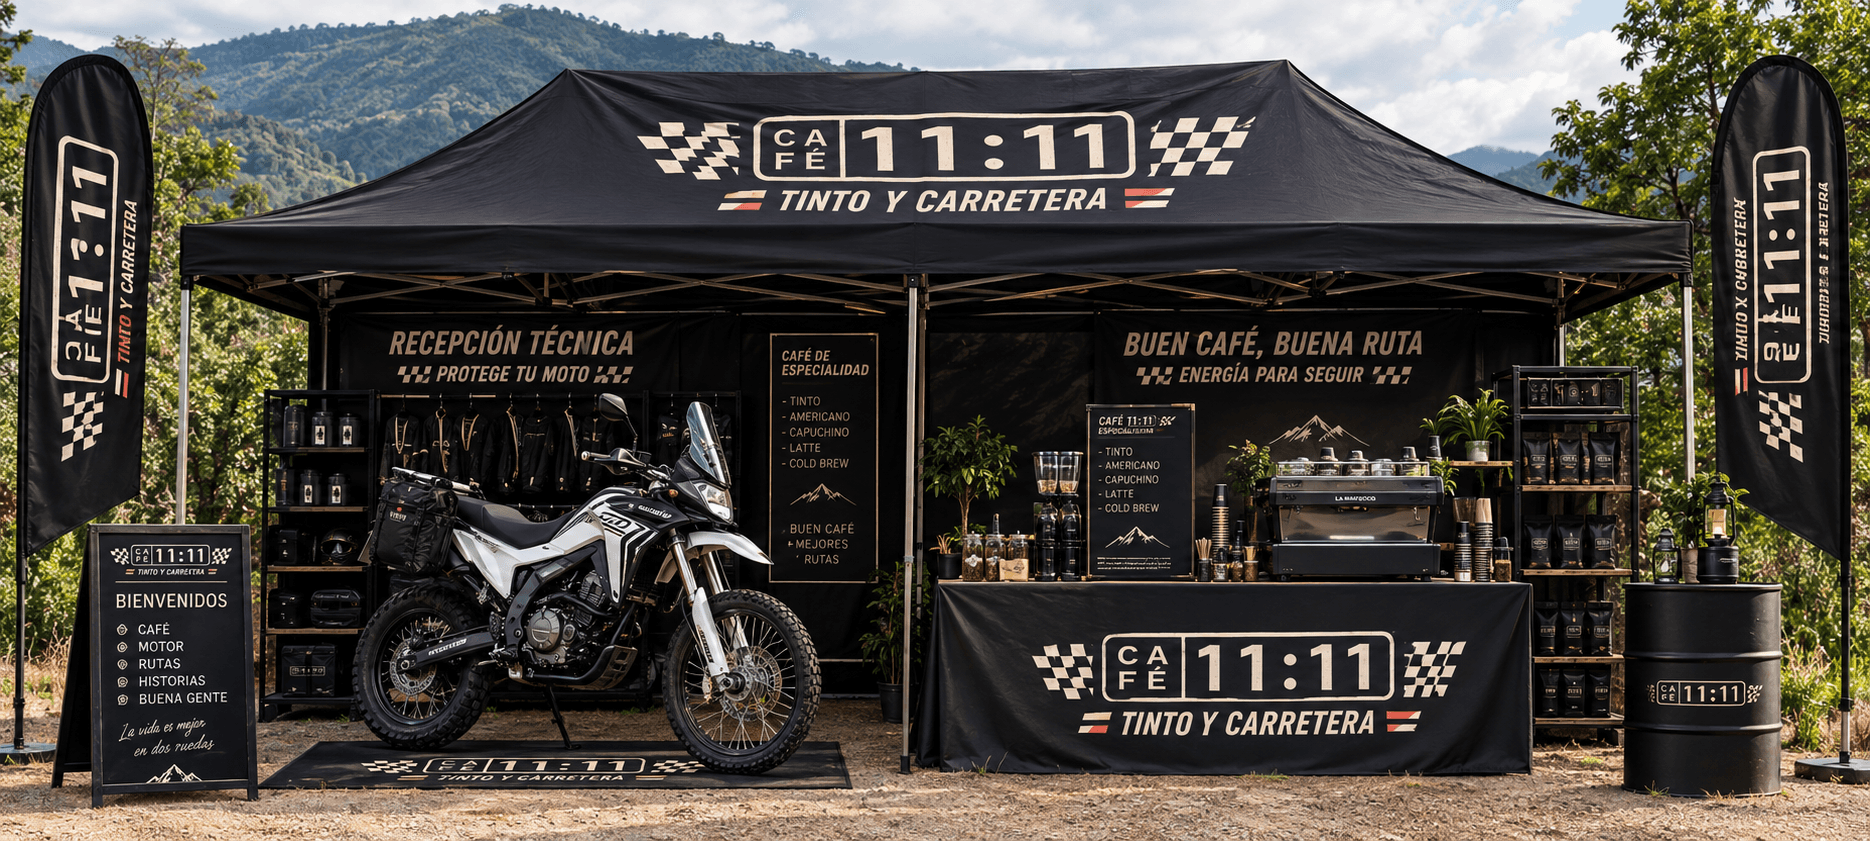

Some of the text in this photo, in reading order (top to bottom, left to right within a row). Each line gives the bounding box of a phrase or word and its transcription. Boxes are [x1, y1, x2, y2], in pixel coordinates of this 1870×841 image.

[774, 128, 827, 147] CA
[861, 124, 1105, 172] 11:11
[775, 148, 826, 170] FÉ
[780, 188, 1107, 213] TINTO Y CARRETERA
[68, 166, 107, 298] 11:11
[1763, 169, 1800, 303] 11:11
[120, 200, 137, 294] CARRETERA
[120, 297, 133, 310] Y
[388, 324, 633, 356] RECEPCIÓN TÉCNICA
[1123, 325, 1422, 360] BUEN CAFÉ, BUENA RUTA
[782, 347, 830, 362] CAFÉ DE
[436, 366, 590, 383] PROTEGE TU MOTO
[782, 364, 870, 376] ESPECIALIDAD
[1178, 362, 1365, 383] ENERGÍA PARA SEGUIR
[790, 396, 821, 406] TINTO
[790, 412, 850, 422] AMERICANO
[1098, 414, 1124, 426] CAFÉ
[790, 428, 850, 438] CAPUCHINO
[790, 443, 821, 453] LATTE
[1105, 447, 1133, 457] TINTO
[790, 459, 850, 469] COLD BREW
[1105, 461, 1160, 470] AMERICANO
[1105, 475, 1159, 485] CAPUCHINO
[1105, 489, 1134, 499] LATTE
[1105, 504, 1160, 513] COLD BREW
[790, 522, 855, 534] BUEN CAFÉ
[156, 548, 204, 563] 11:11
[805, 554, 839, 565] RUTAS
[116, 593, 228, 608] BIENVENIDOS
[138, 622, 170, 635] CAFÉ
[138, 641, 184, 652] MOTOR
[1118, 646, 1169, 665] CA
[139, 658, 181, 670] RUTAS
[1198, 643, 1370, 692] 11:11
[139, 675, 206, 687] HISTORIAS
[1118, 666, 1167, 691] FÉ
[1661, 685, 1676, 693] CA
[1684, 685, 1738, 702] 11:11
[139, 692, 228, 705] BUENA GENTE
[118, 717, 207, 742] La vida es mejor
[1122, 710, 1374, 736] TINTO Y CARRETERA
[134, 734, 215, 757] en dos ruedas
[500, 761, 625, 771] 11:11
